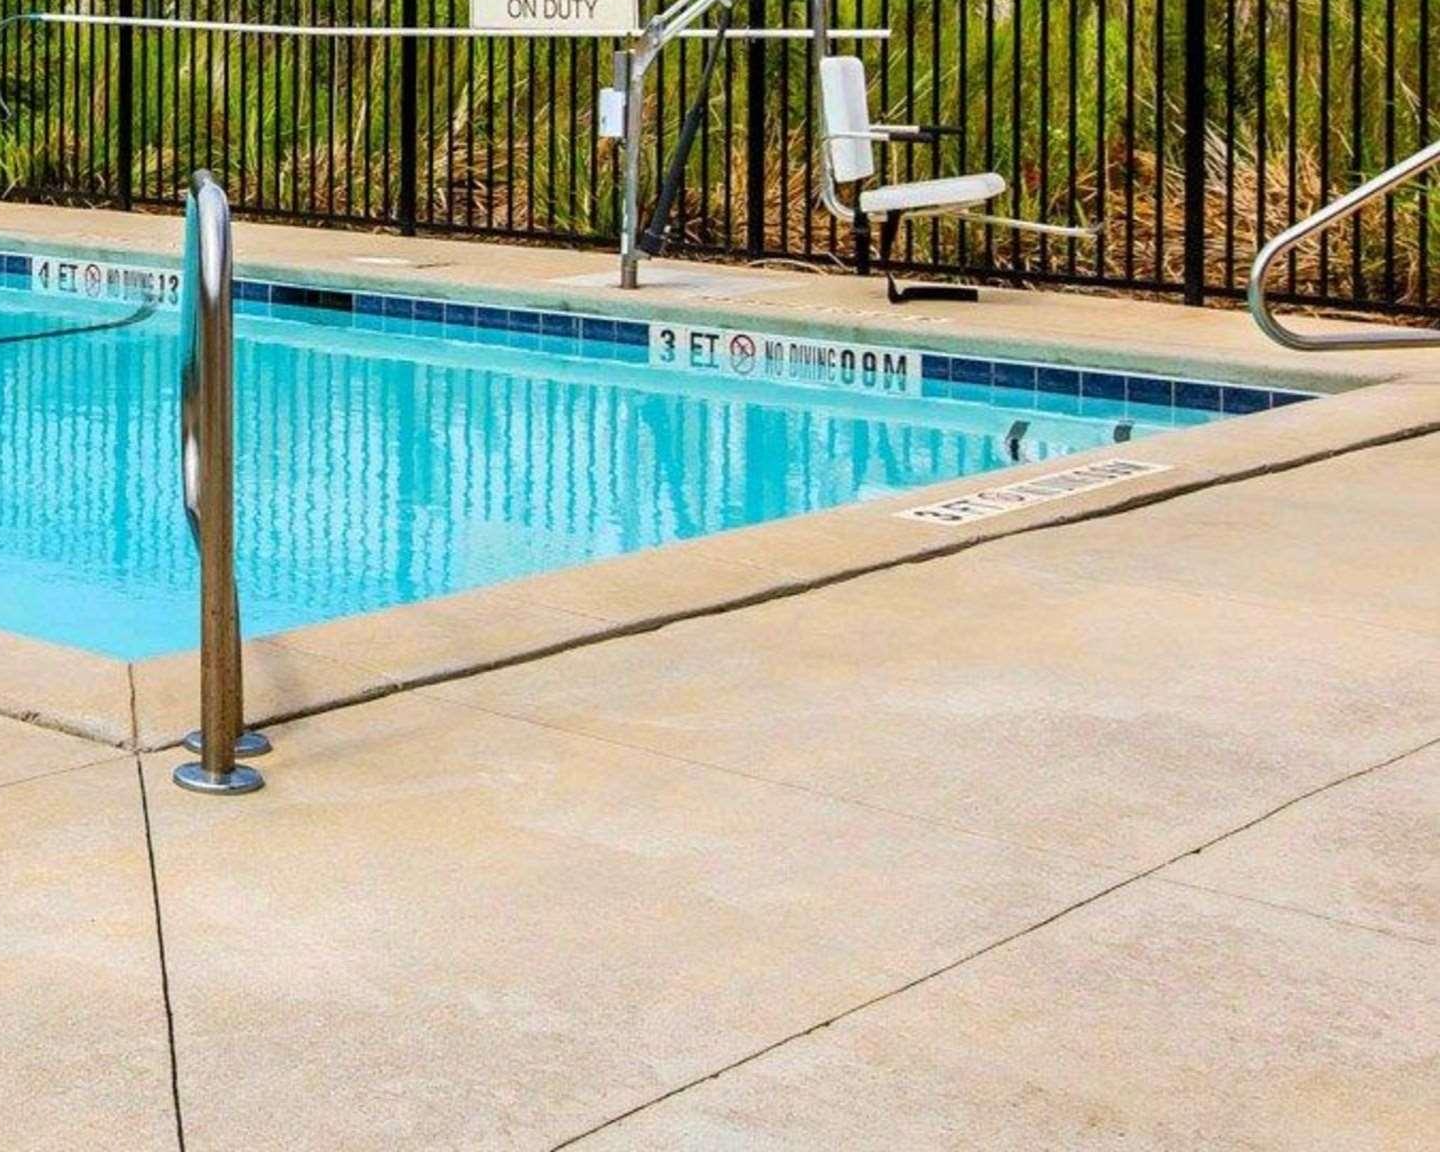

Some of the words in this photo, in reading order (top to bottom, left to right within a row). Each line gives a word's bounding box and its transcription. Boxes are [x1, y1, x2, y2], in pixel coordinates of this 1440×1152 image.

[660, 330, 676, 362] 3
[765, 340, 783, 376] NO
[789, 343, 836, 382] DIVING
